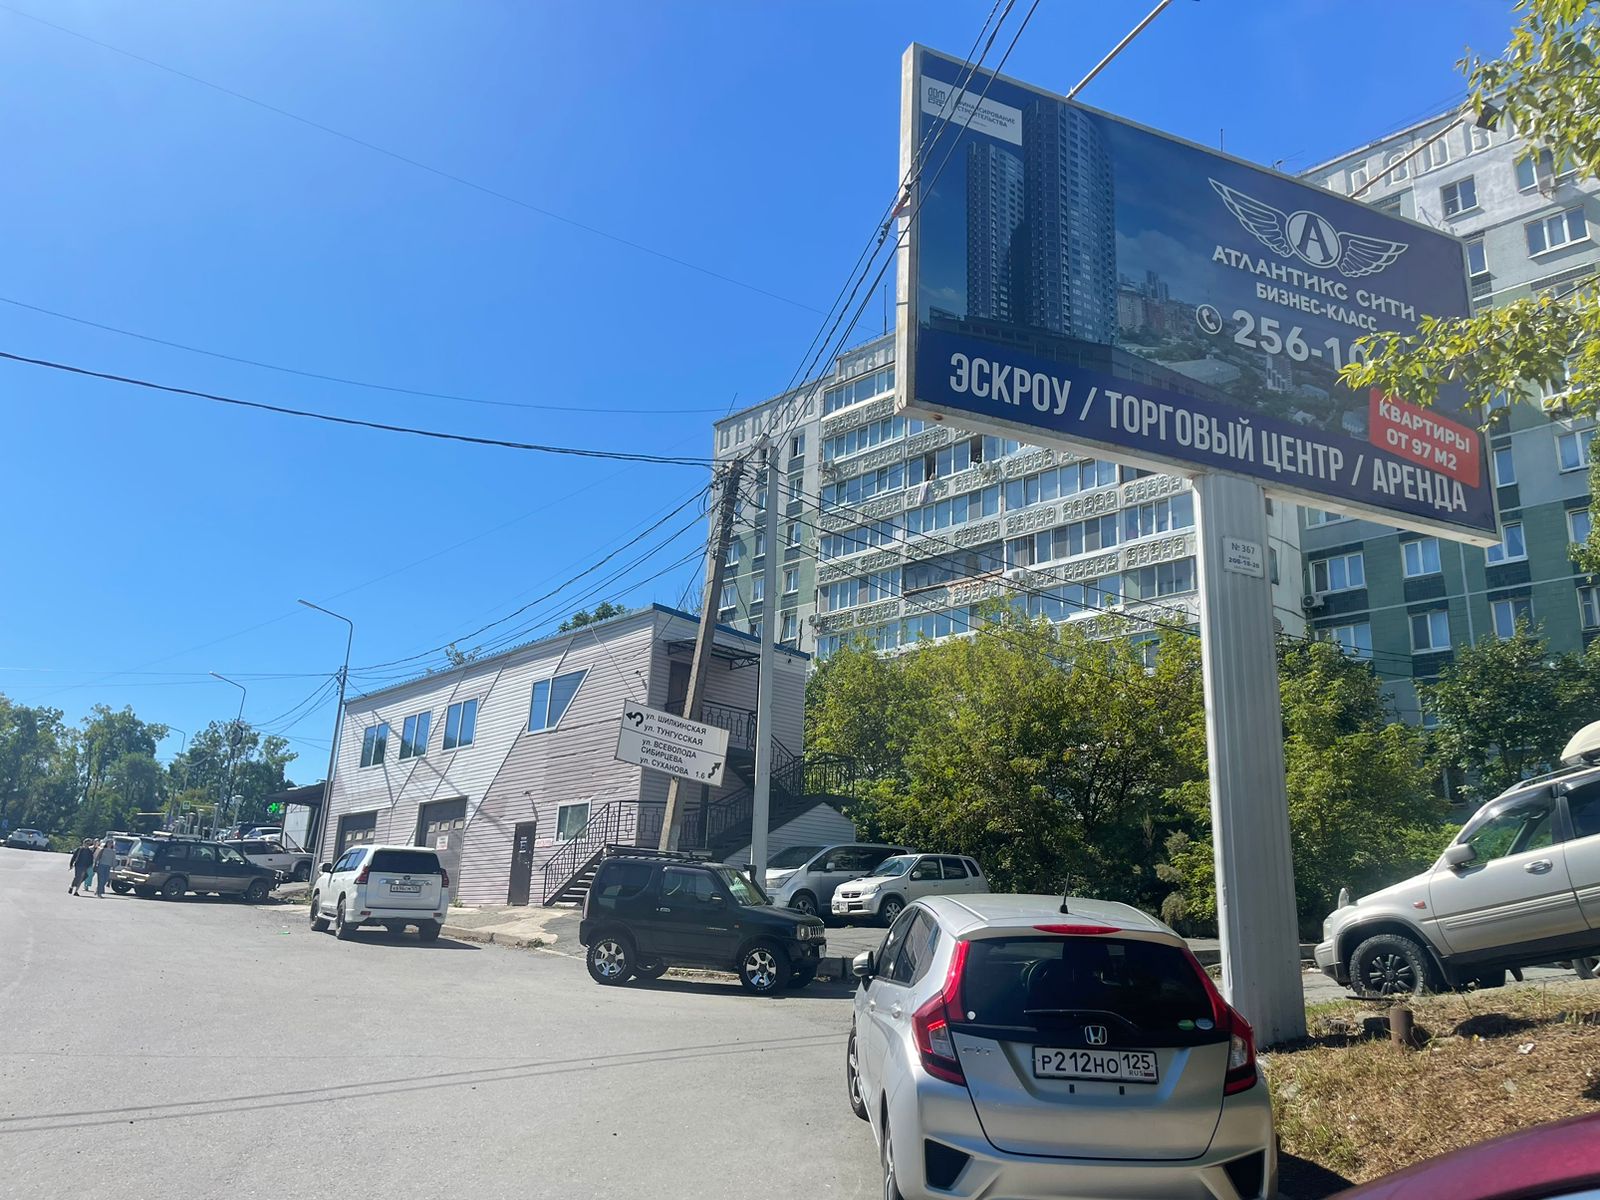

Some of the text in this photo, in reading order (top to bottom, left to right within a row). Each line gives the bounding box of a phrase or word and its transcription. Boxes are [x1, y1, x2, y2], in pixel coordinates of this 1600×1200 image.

[1212, 245, 1417, 322] АТЛАНТИКС СИТИ
[1256, 282, 1378, 332] БИЗНЕС-КЛАСС
[950, 352, 1072, 415] ЭСКРОУ
[1104, 389, 1255, 463] ТОРГОВЫЙ
[1261, 430, 1344, 482] ЦЕНТР
[1372, 458, 1468, 513] АРЕНДА
[1379, 400, 1470, 453] КВАРТИРЫ
[1386, 428, 1458, 472] ОТ 97 М2
[643, 724, 704, 747] ул. ТУНГУССКАЯ
[645, 713, 707, 735] ул. ШИЛКИНСКАЯ
[640, 746, 684, 764] СИБИРЦЕВА
[641, 738, 697, 759] ул. ВСЕВОЛОДА
[639, 756, 650, 765] ул.
[651, 759, 689, 776] СУХАНОВА
[1122, 1053, 1151, 1070] 125
